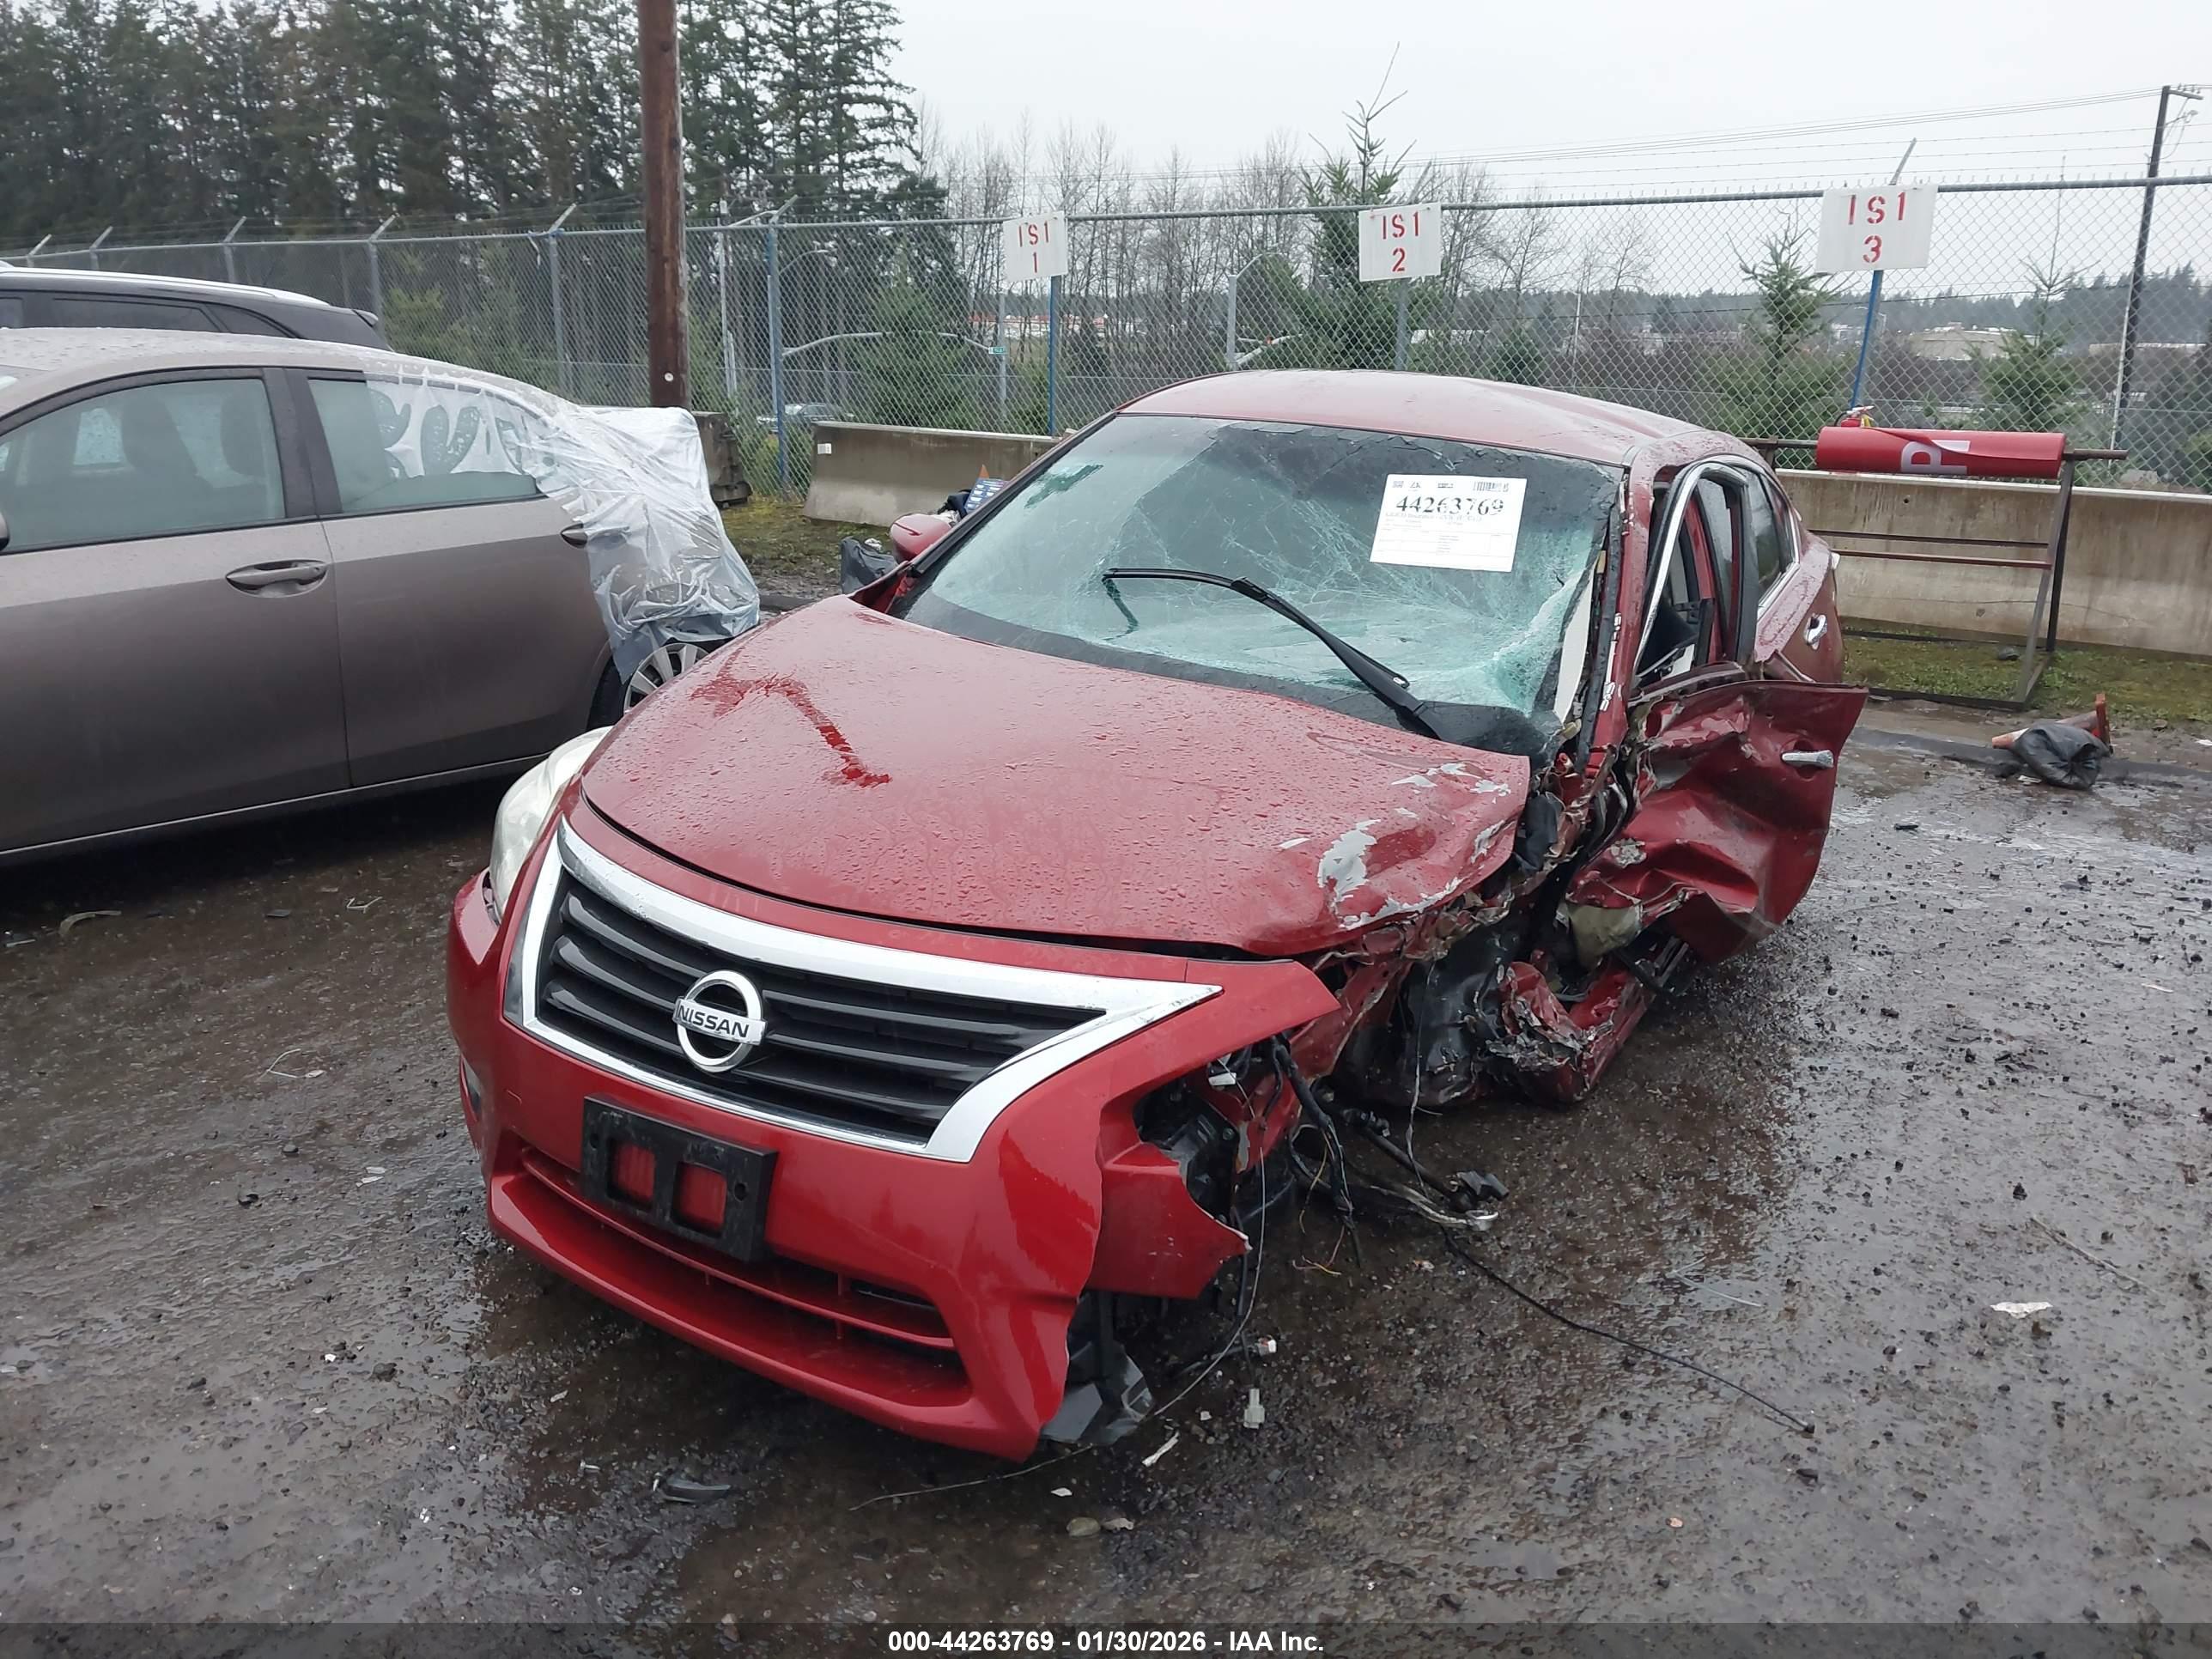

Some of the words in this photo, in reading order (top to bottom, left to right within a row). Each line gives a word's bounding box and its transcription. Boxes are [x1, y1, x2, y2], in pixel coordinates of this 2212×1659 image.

[1392, 247, 1405, 272] 2
[1863, 235, 1882, 263] 3
[1032, 252, 1038, 273] 1
[1395, 495, 1504, 516] 44263769
[677, 1005, 750, 1038] NISSAN
